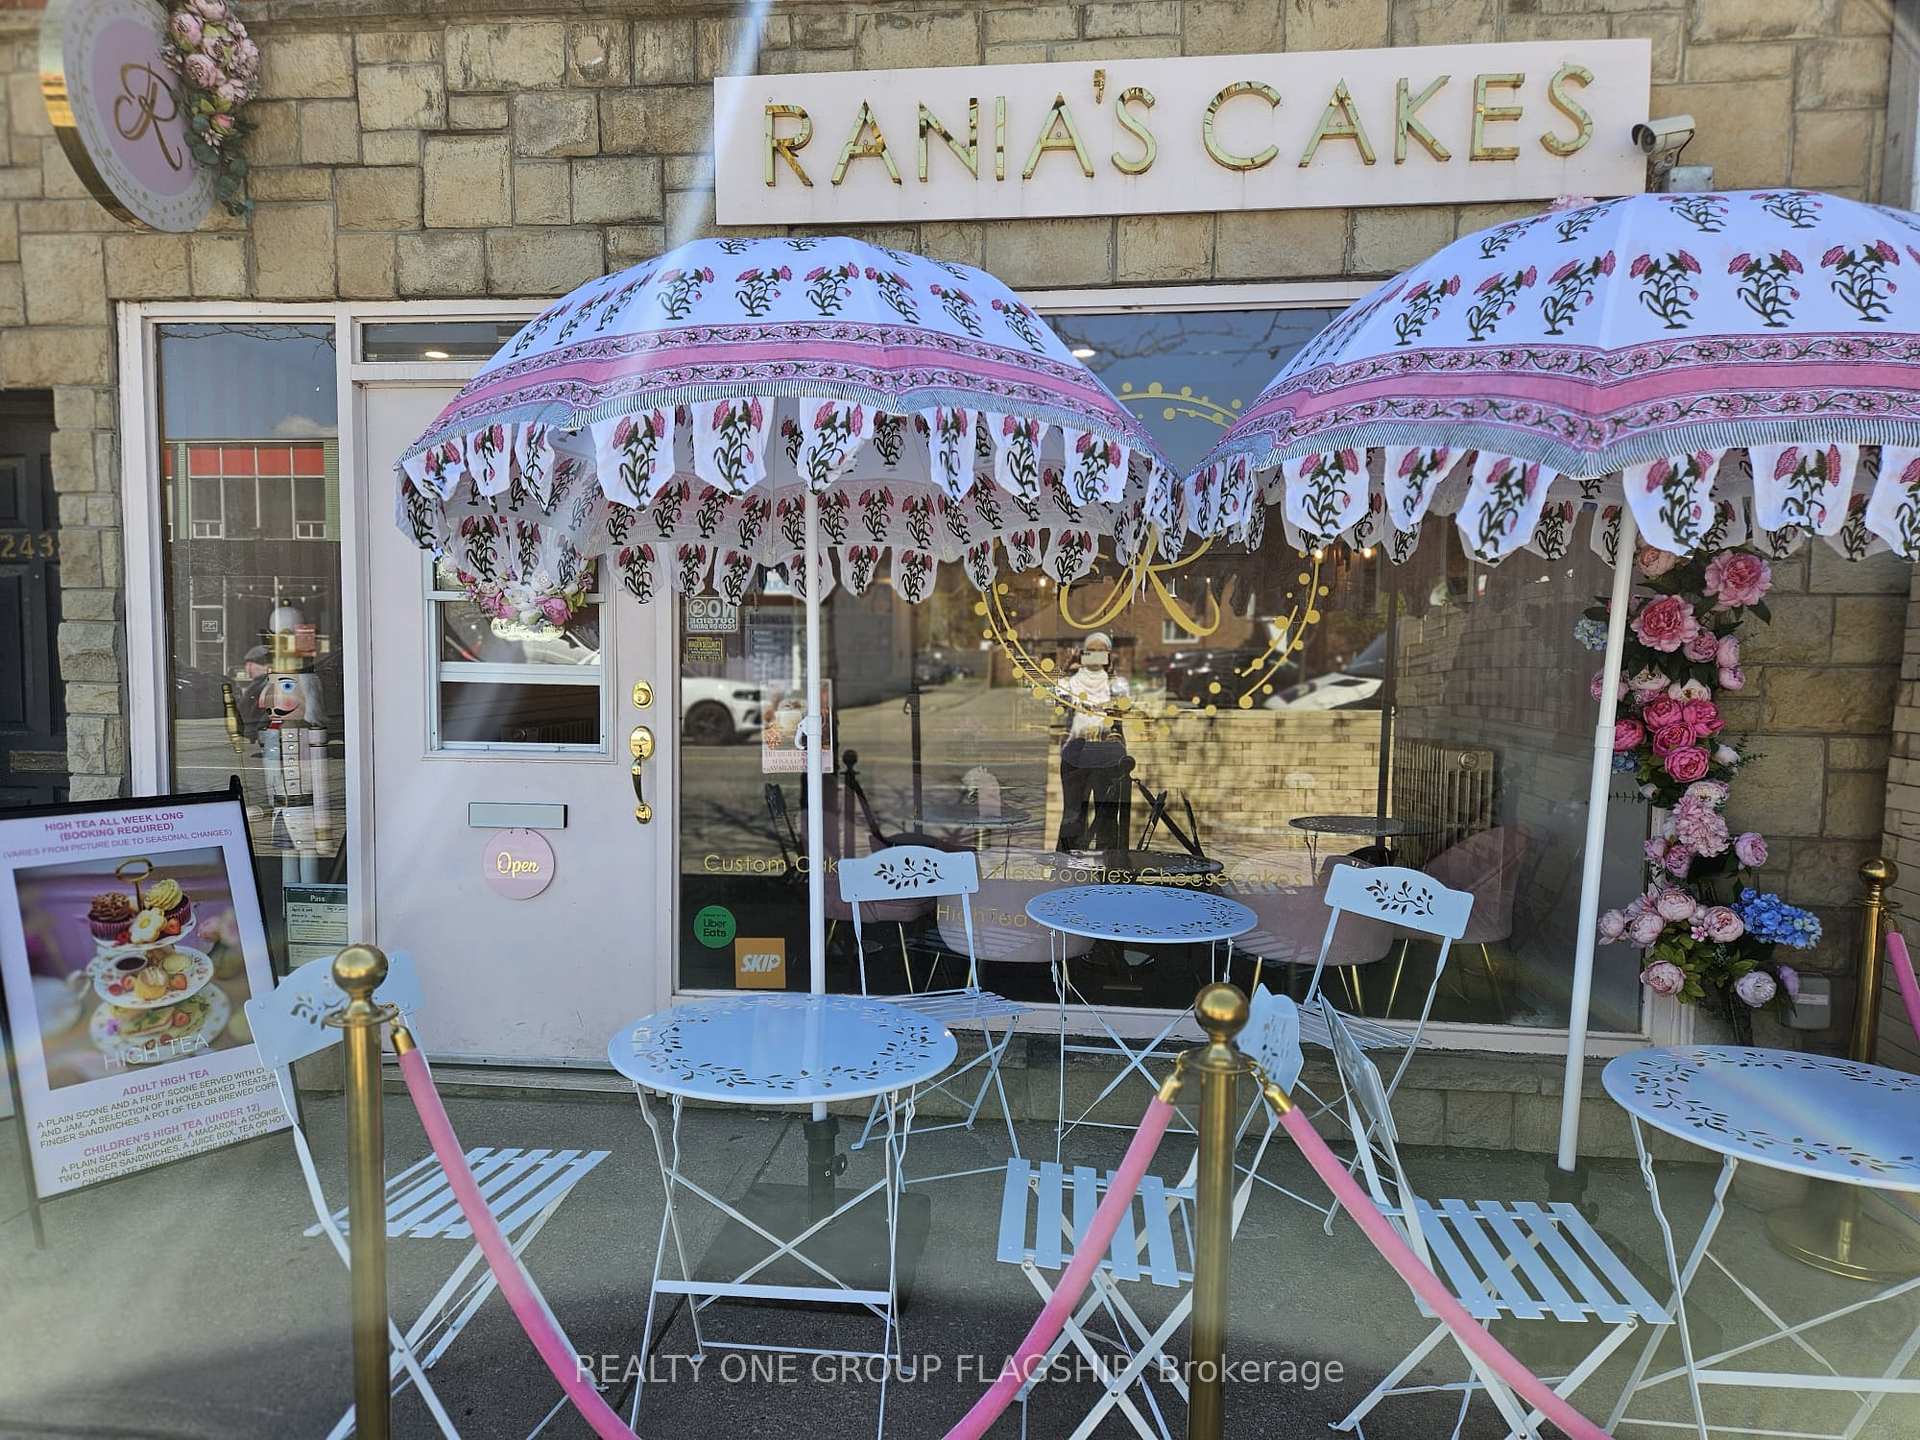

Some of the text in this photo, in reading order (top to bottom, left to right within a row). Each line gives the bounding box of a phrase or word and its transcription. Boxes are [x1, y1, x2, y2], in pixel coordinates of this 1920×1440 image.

[765, 64, 1594, 187] RANIA'S CAKES
[45, 811, 185, 832] HIGH TEA ALL WEEK LONG
[59, 822, 174, 842] (BOOKING REQUIRED)
[42, 845, 69, 855] FROM
[70, 840, 110, 852] PICTURE
[111, 838, 130, 847] DUE
[132, 836, 144, 845] TO
[145, 832, 189, 844] SEASONAL
[191, 828, 233, 839] CHANGES)
[497, 851, 539, 878] Open
[704, 855, 786, 873] Custom
[1140, 867, 1306, 887] Cheesecakes
[703, 918, 727, 928] Uber
[703, 929, 727, 937] Eats
[740, 954, 781, 973] SKIP
[103, 1033, 209, 1071] HIGH TEA
[122, 1068, 210, 1096] ADULT HIGH TEA
[41, 1127, 62, 1138] AND
[98, 1105, 149, 1124] SELECTION
[151, 1102, 163, 1110] OF
[176, 1092, 205, 1104] HOUSE
[208, 1084, 235, 1096] BAKED
[238, 1075, 268, 1088] TREATS
[47, 1113, 74, 1126] PLAIN
[76, 1105, 109, 1120] SCONE
[111, 1100, 130, 1110] AND
[140, 1091, 165, 1104] FRUIT
[168, 1083, 198, 1097] SCONE
[200, 1074, 233, 1088] SERVED
[234, 1069, 255, 1080] WITH
[40, 1133, 76, 1149] FINGER
[152, 1109, 170, 1120] POT
[171, 1106, 184, 1114] OF
[186, 1101, 203, 1111] TEA
[204, 1097, 217, 1106] OR
[218, 1088, 254, 1103] BREWED
[84, 1102, 260, 1157] CHILDREN'S HIGH TEA (UNDER 12)
[58, 1172, 80, 1183] TWO
[82, 1162, 117, 1177] FINGER
[190, 1135, 216, 1147] JUICE
[239, 1124, 254, 1133] TEA
[255, 1120, 268, 1128] OR
[269, 1115, 285, 1125] HOT
[70, 1158, 97, 1170] PLAIN
